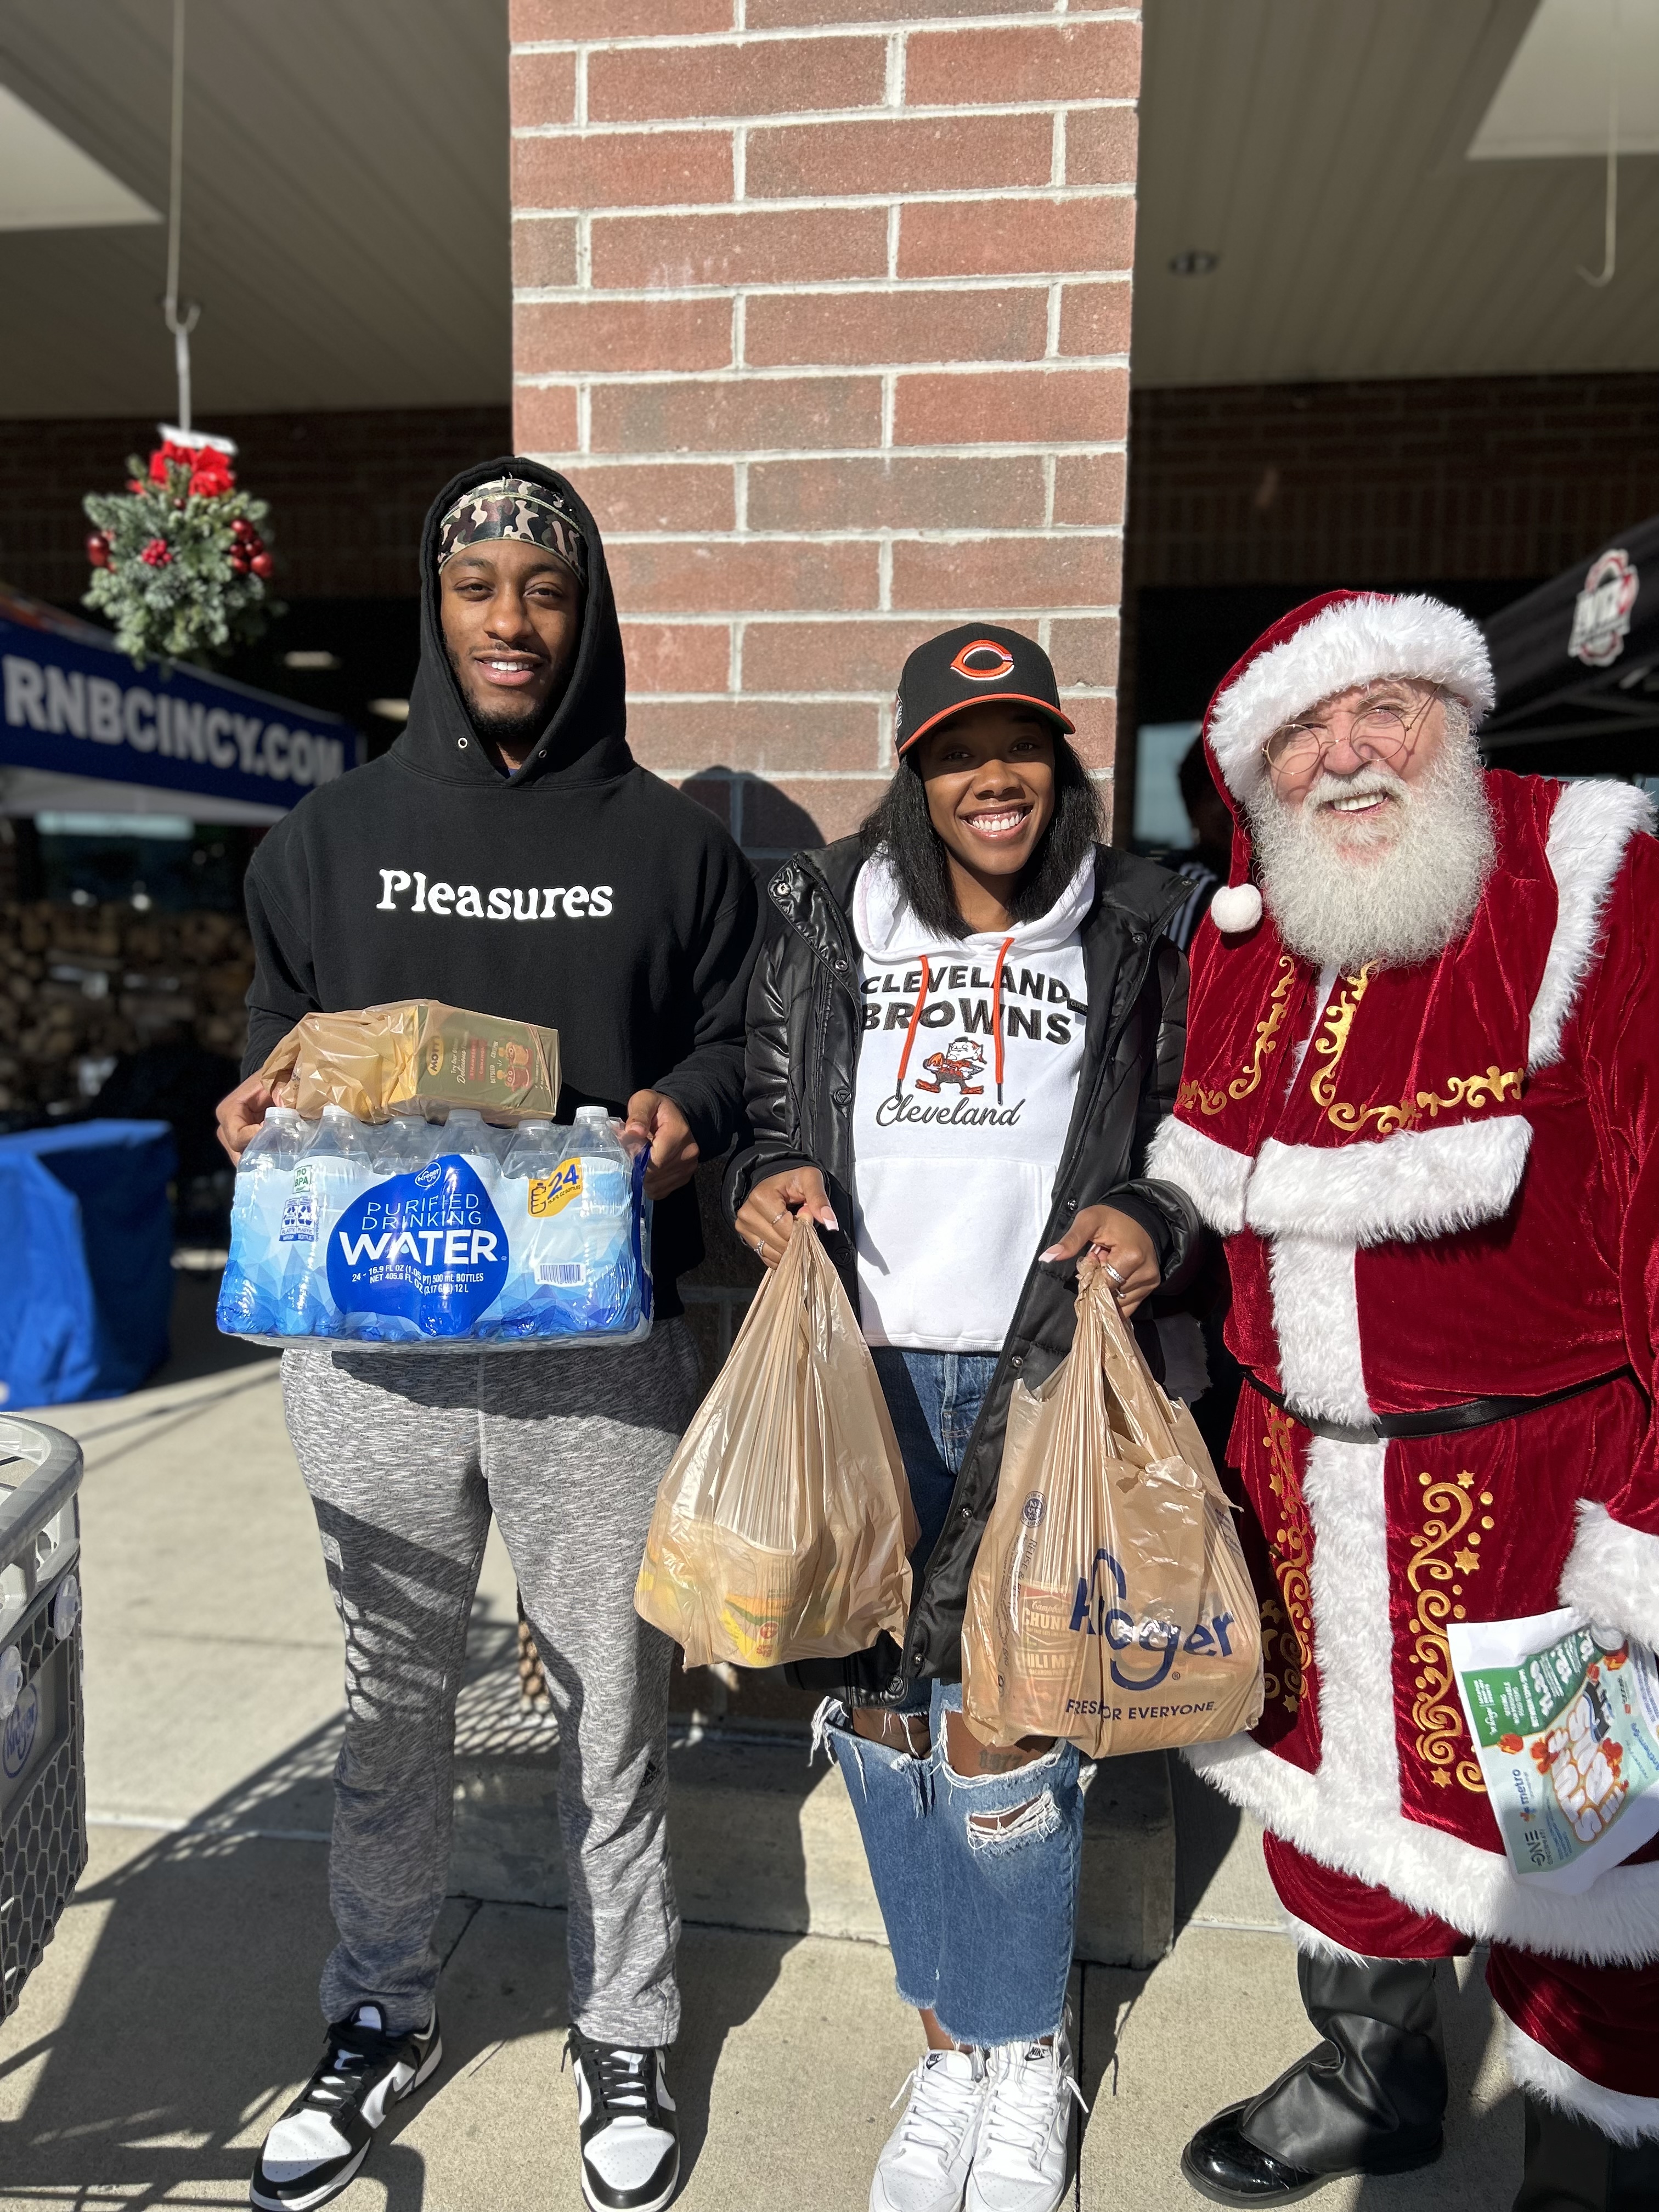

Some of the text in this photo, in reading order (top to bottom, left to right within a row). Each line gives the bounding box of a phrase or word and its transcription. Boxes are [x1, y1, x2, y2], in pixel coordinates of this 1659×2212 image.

[4, 654, 345, 787] RNBCINCY.COM
[376, 868, 613, 919] Pleasures
[860, 966, 1070, 1003] CLEVELAND
[862, 998, 1071, 1045] BROWNS
[456, 1049, 466, 1084] Delicious
[876, 1094, 1025, 1126] Cleveland
[295, 1176, 308, 1187] BPA
[417, 1168, 439, 1183] Kroger
[548, 1164, 579, 1200] 24
[362, 1211, 481, 1230] DRINKING
[367, 1194, 479, 1215] PURIFIED
[338, 1229, 498, 1266] WATER
[352, 1273, 361, 1282] 24
[369, 1265, 383, 1275] 16.9
[405, 1265, 421, 1279] (1.05
[422, 1274, 431, 1285] PT)
[432, 1273, 443, 1283] 500
[444, 1273, 454, 1282] mL
[456, 1273, 484, 1282] BOTTLES
[370, 1273, 383, 1284] NET
[385, 1272, 403, 1280] 405.6
[405, 1274, 413, 1283] FL
[414, 1277, 423, 1295] OZ
[455, 1284, 463, 1293] 12
[464, 1284, 469, 1293] L
[1021, 1538, 1037, 1571] REUSE
[1511, 1768, 1530, 1805] metro
[1029, 2046, 1046, 2056] NIKE
